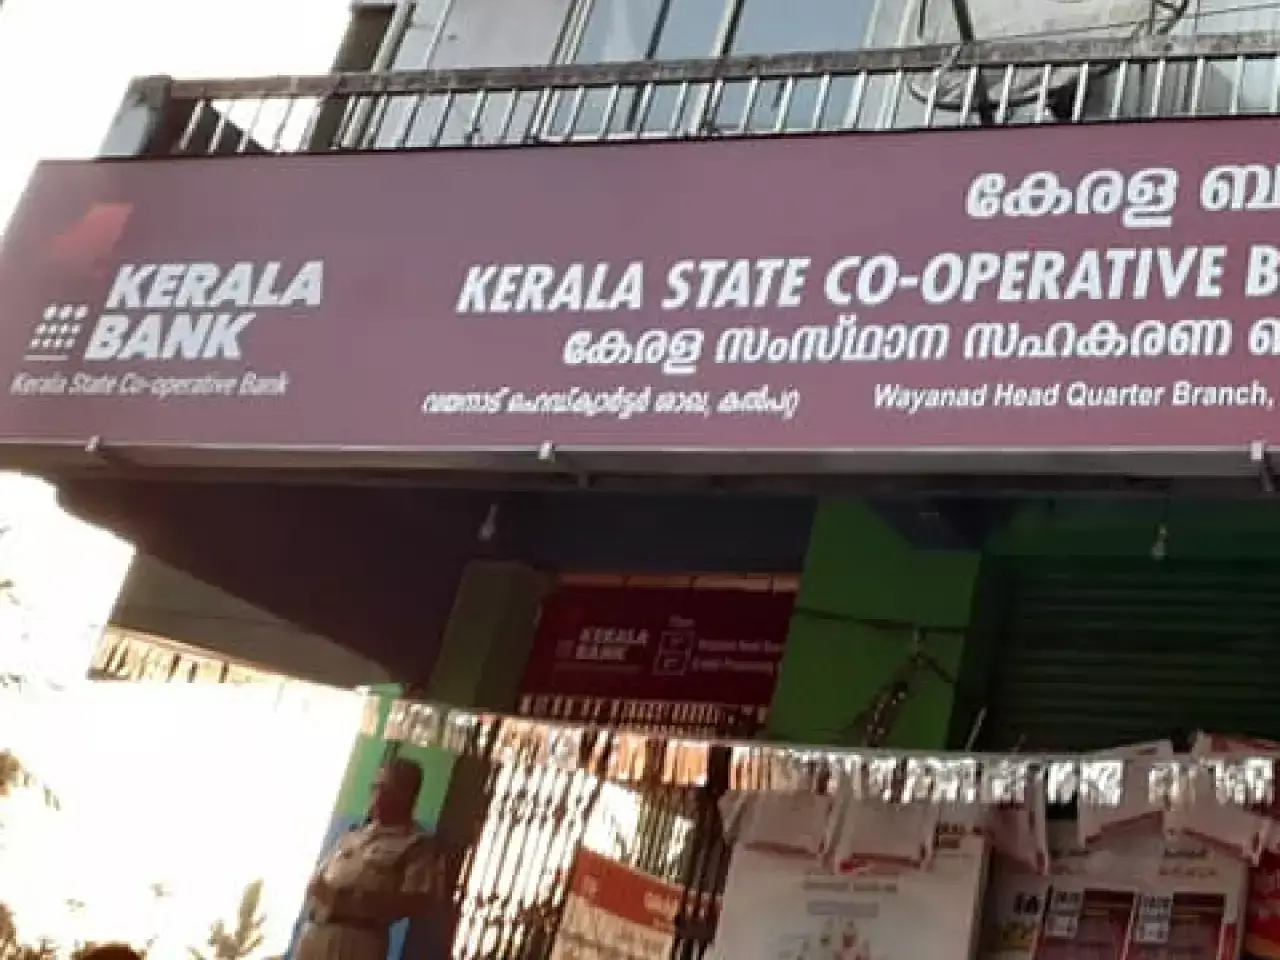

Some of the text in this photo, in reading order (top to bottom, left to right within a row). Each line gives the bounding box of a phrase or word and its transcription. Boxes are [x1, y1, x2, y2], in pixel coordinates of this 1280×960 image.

[966, 167, 1179, 228] കേരള
[105, 260, 325, 310] KERALA
[456, 261, 643, 313] KERALA
[662, 256, 811, 311] STATE
[824, 248, 1228, 305] CO-OPERATIVE
[83, 313, 257, 362] BANK
[563, 330, 704, 374] കേരള
[962, 317, 1232, 358] സഹകരണ
[873, 382, 987, 414] Wayanad
[995, 381, 1060, 406] Head
[1065, 381, 1164, 408] Quarter
[1171, 379, 1276, 410] Branch,
